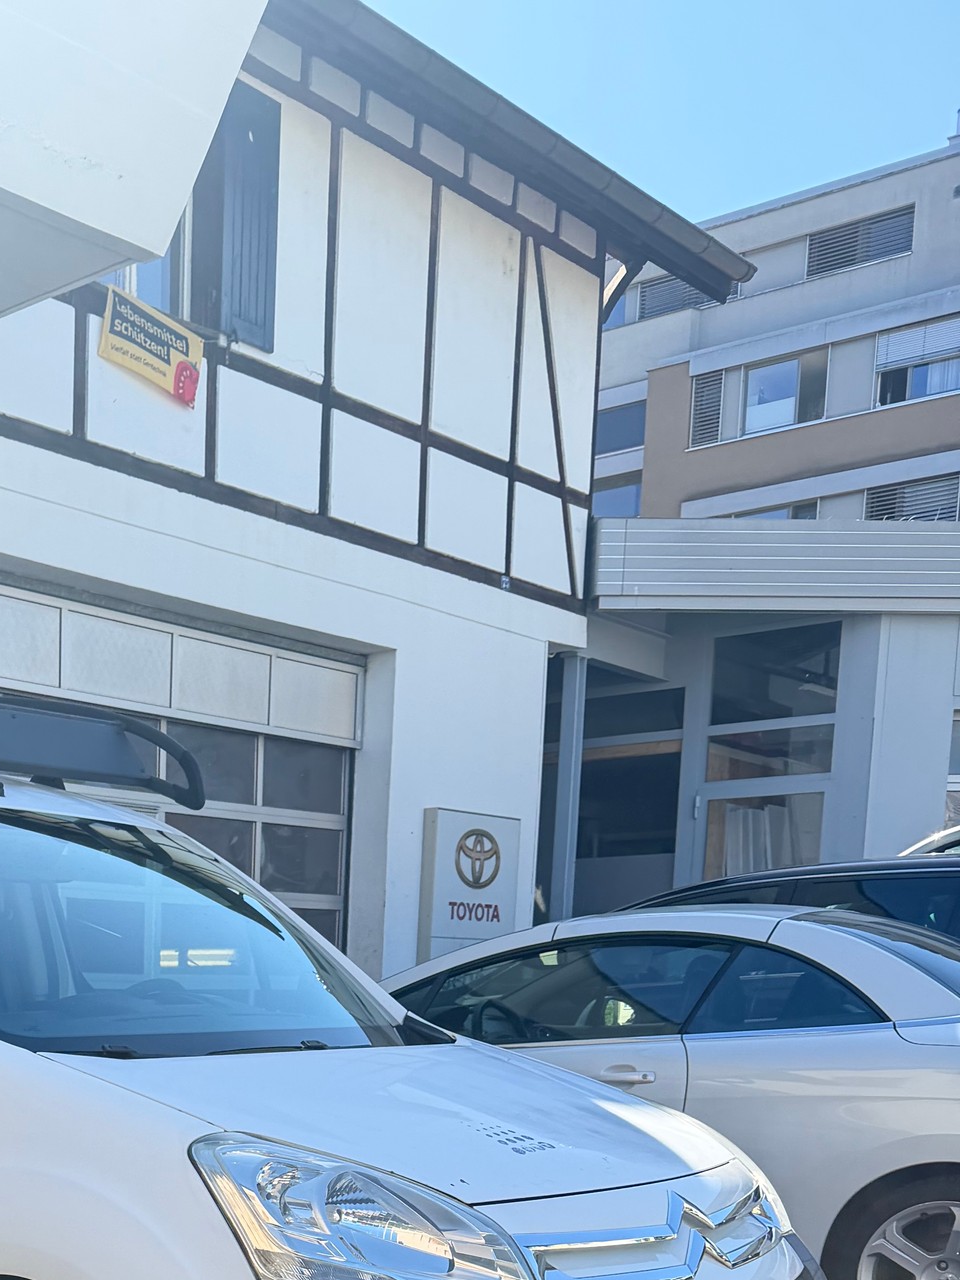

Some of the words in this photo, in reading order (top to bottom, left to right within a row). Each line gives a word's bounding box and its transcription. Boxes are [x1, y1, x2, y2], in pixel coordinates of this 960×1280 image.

[113, 318, 168, 360] schützen!
[114, 296, 187, 353] Lebensmittel
[448, 901, 501, 923] TOYOTA
